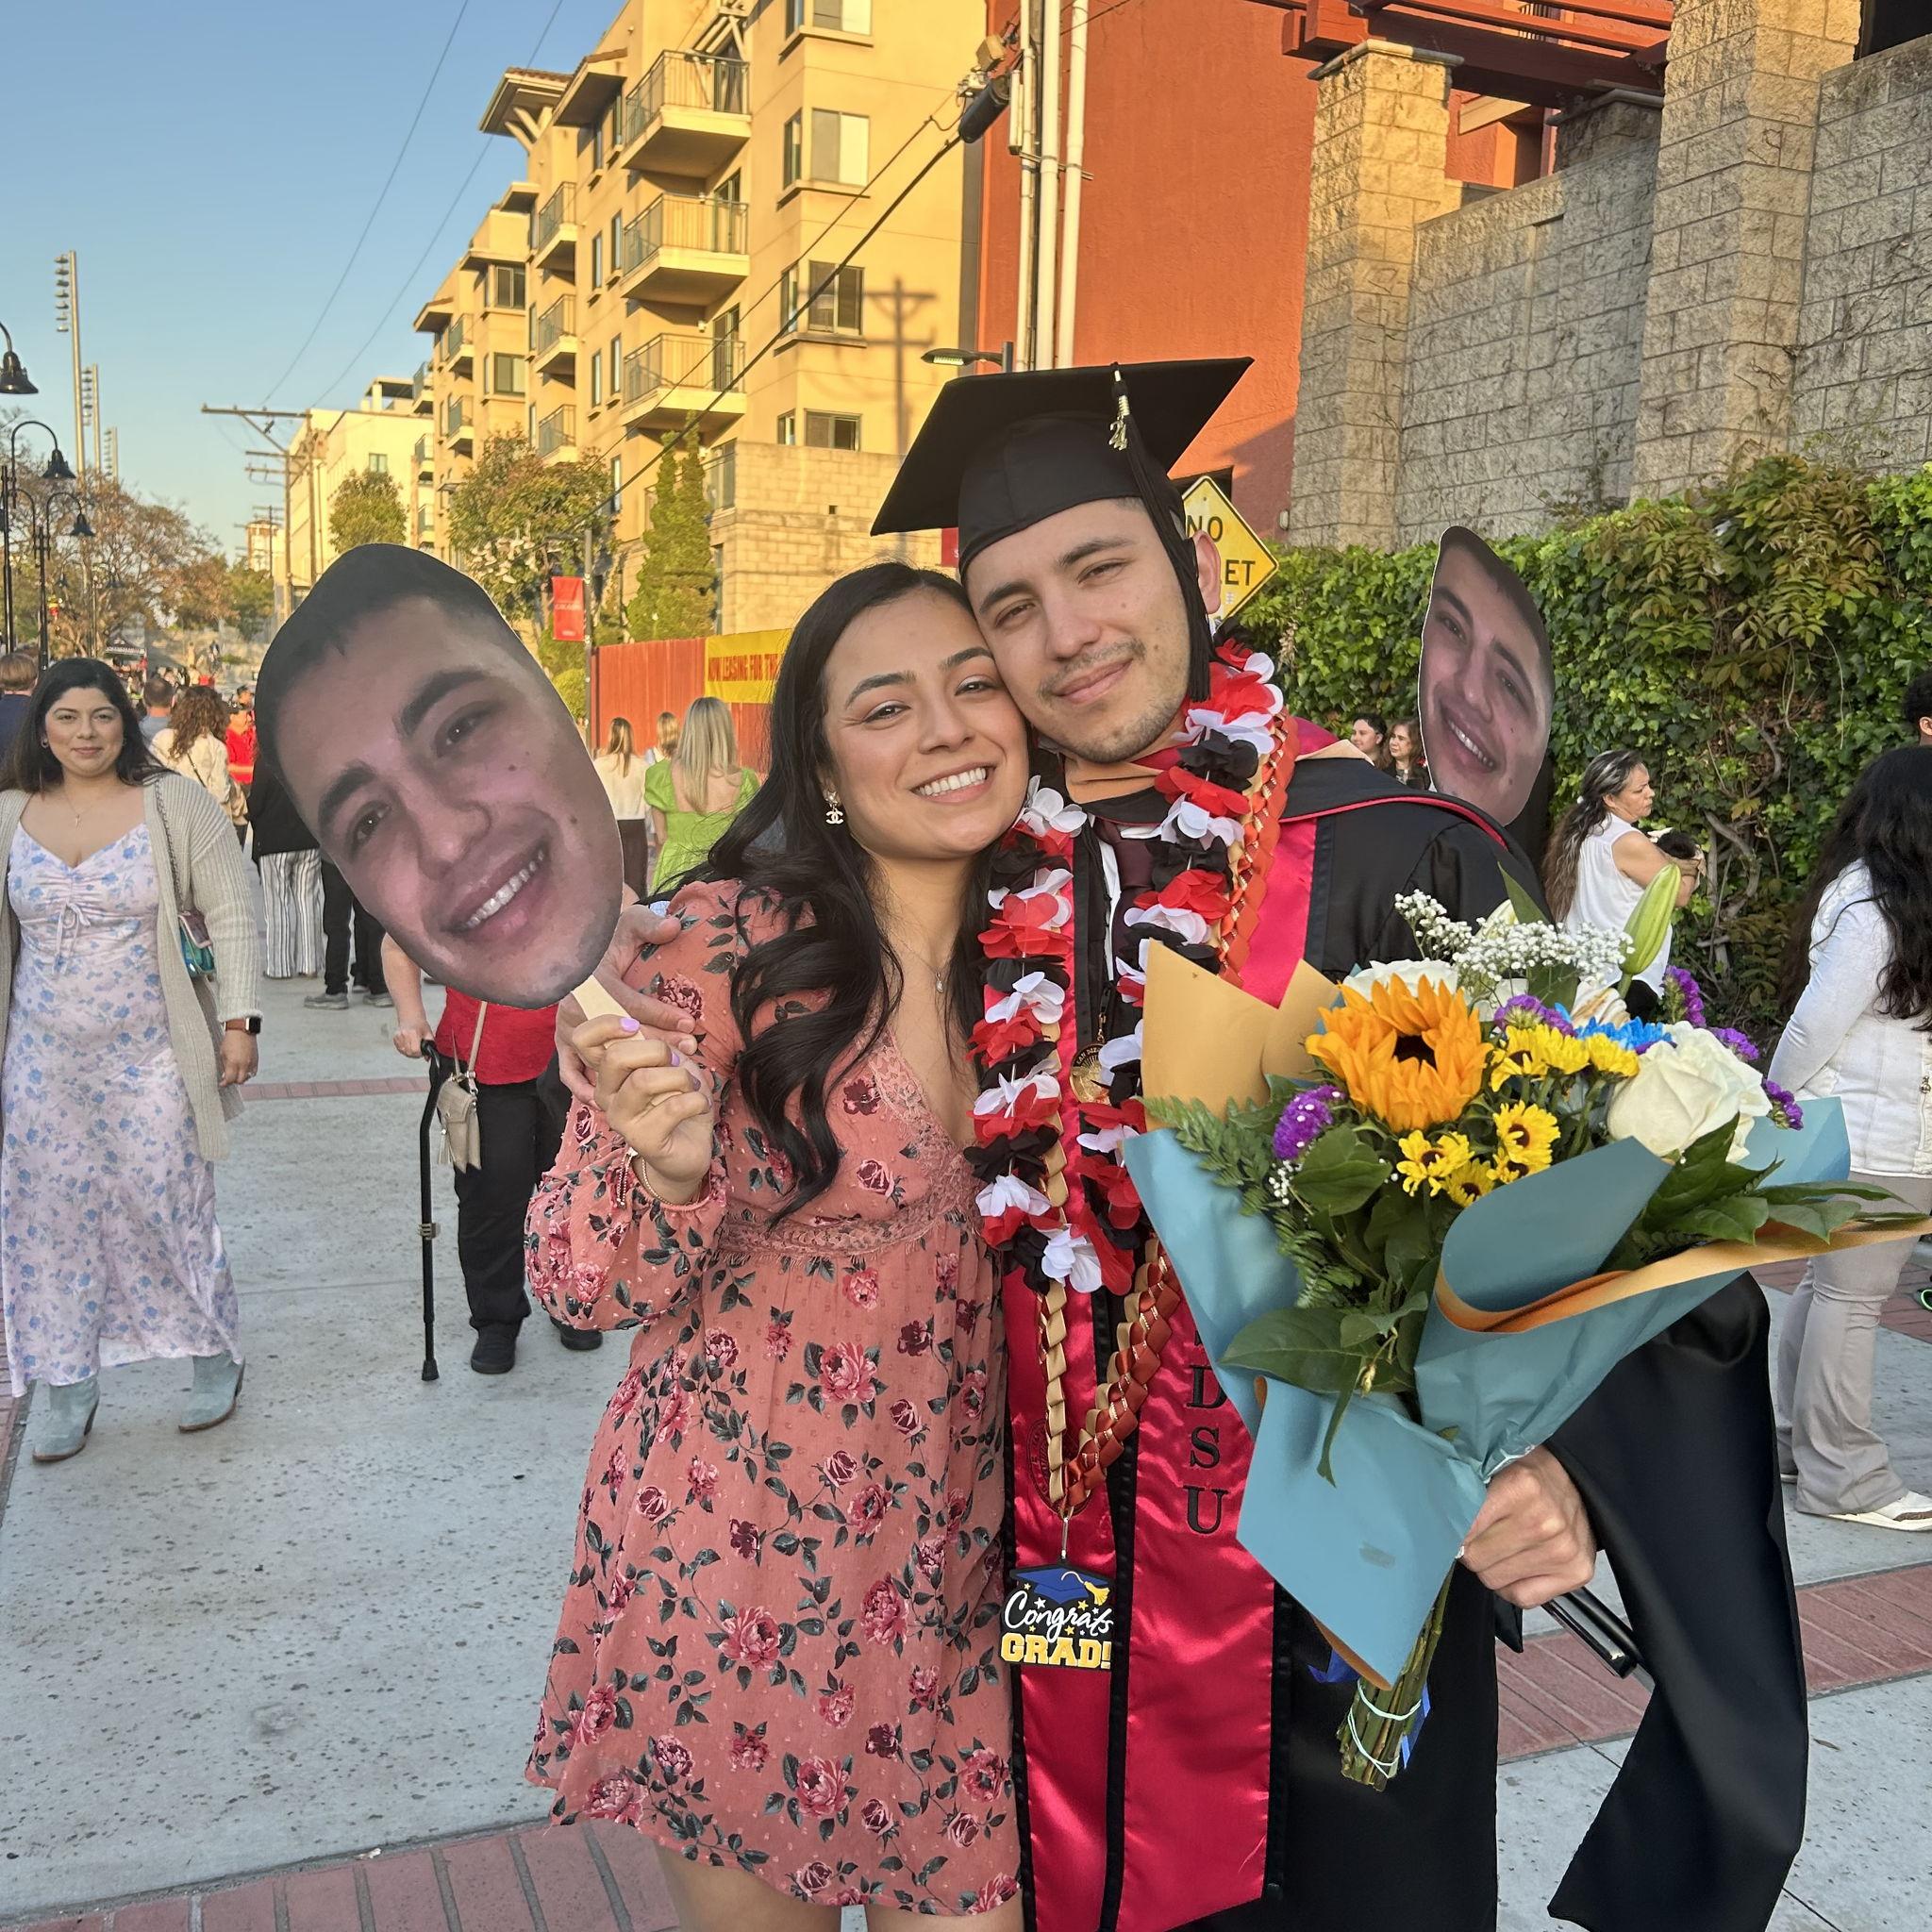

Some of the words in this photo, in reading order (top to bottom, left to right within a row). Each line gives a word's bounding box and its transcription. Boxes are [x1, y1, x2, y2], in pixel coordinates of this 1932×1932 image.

[1187, 515, 1224, 542] NO
[1183, 1330, 1229, 1535] DSU
[1005, 1590, 1114, 1643] Congrats
[1000, 1632, 1112, 1670] GRAD!
